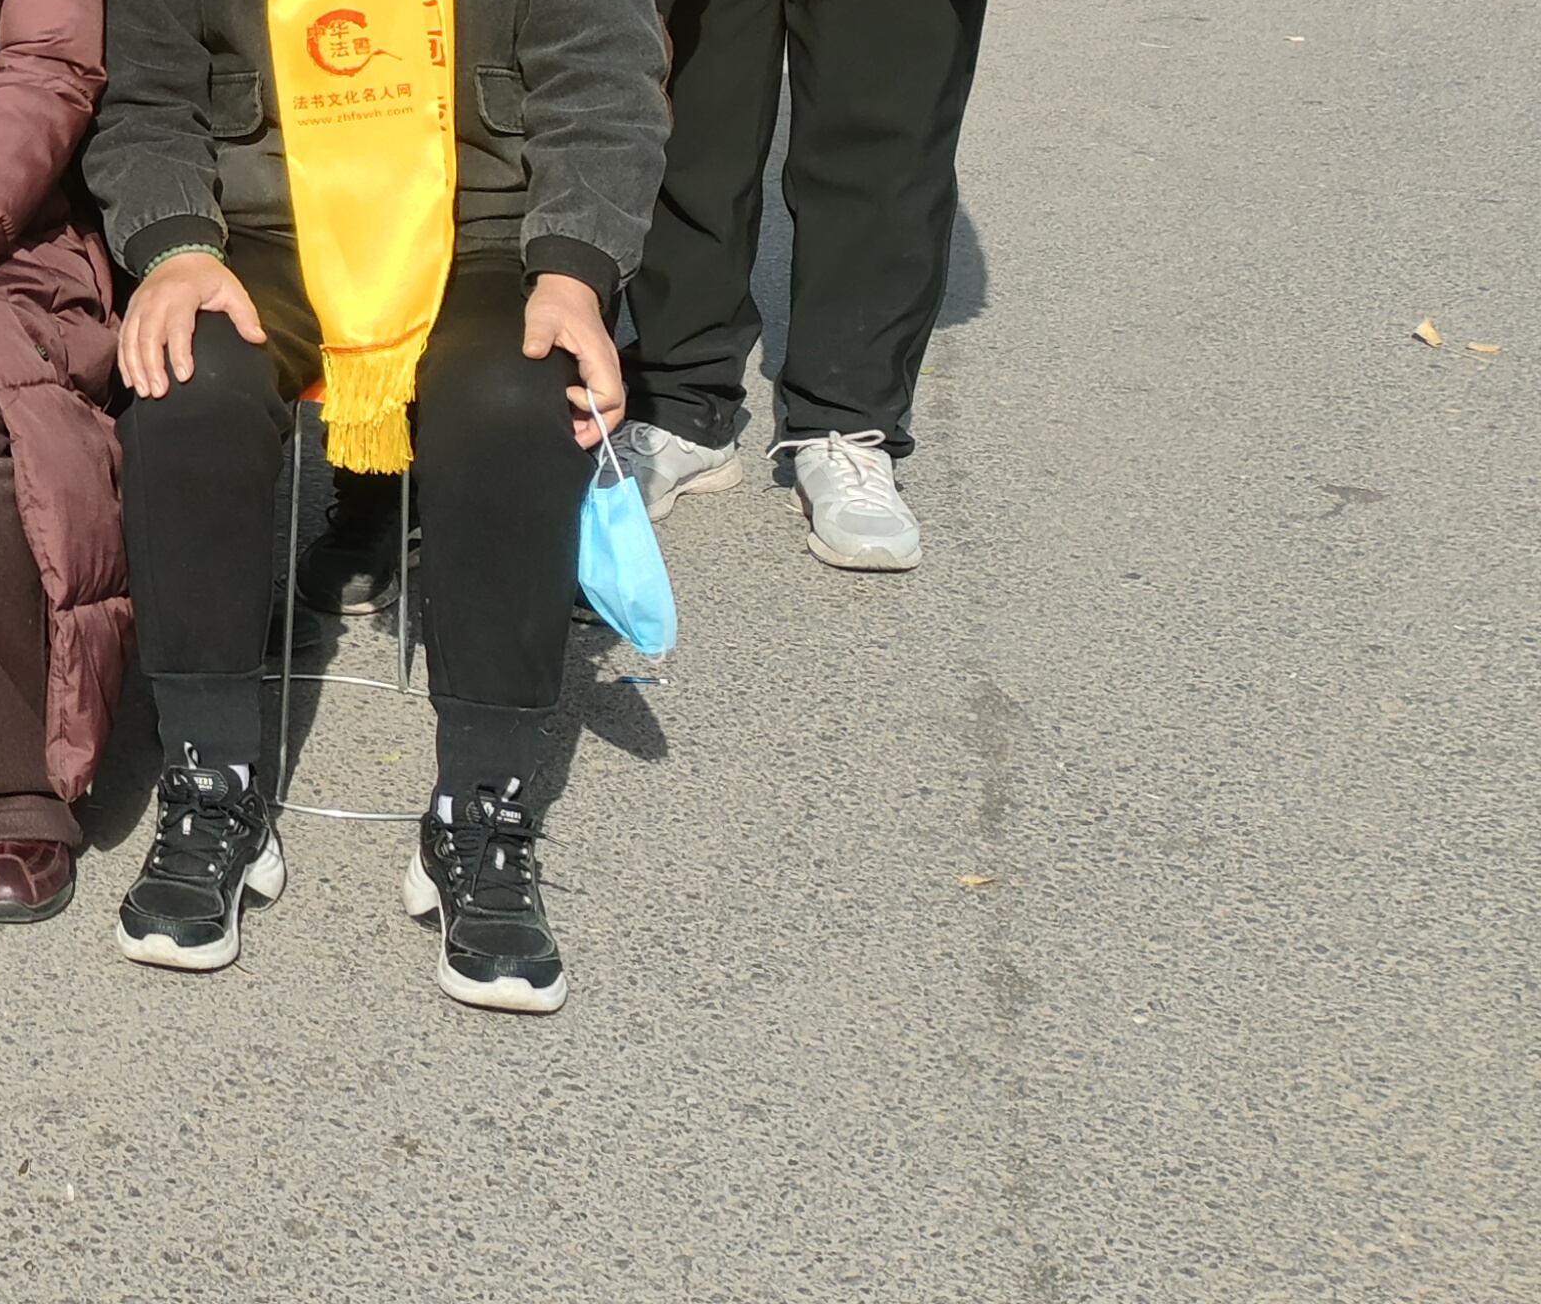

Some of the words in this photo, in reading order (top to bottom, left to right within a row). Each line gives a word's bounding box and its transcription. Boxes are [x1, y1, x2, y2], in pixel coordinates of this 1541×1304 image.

[293, 82, 413, 111] 法书文化名人网
[297, 105, 414, 127] www.zhfswh.com
